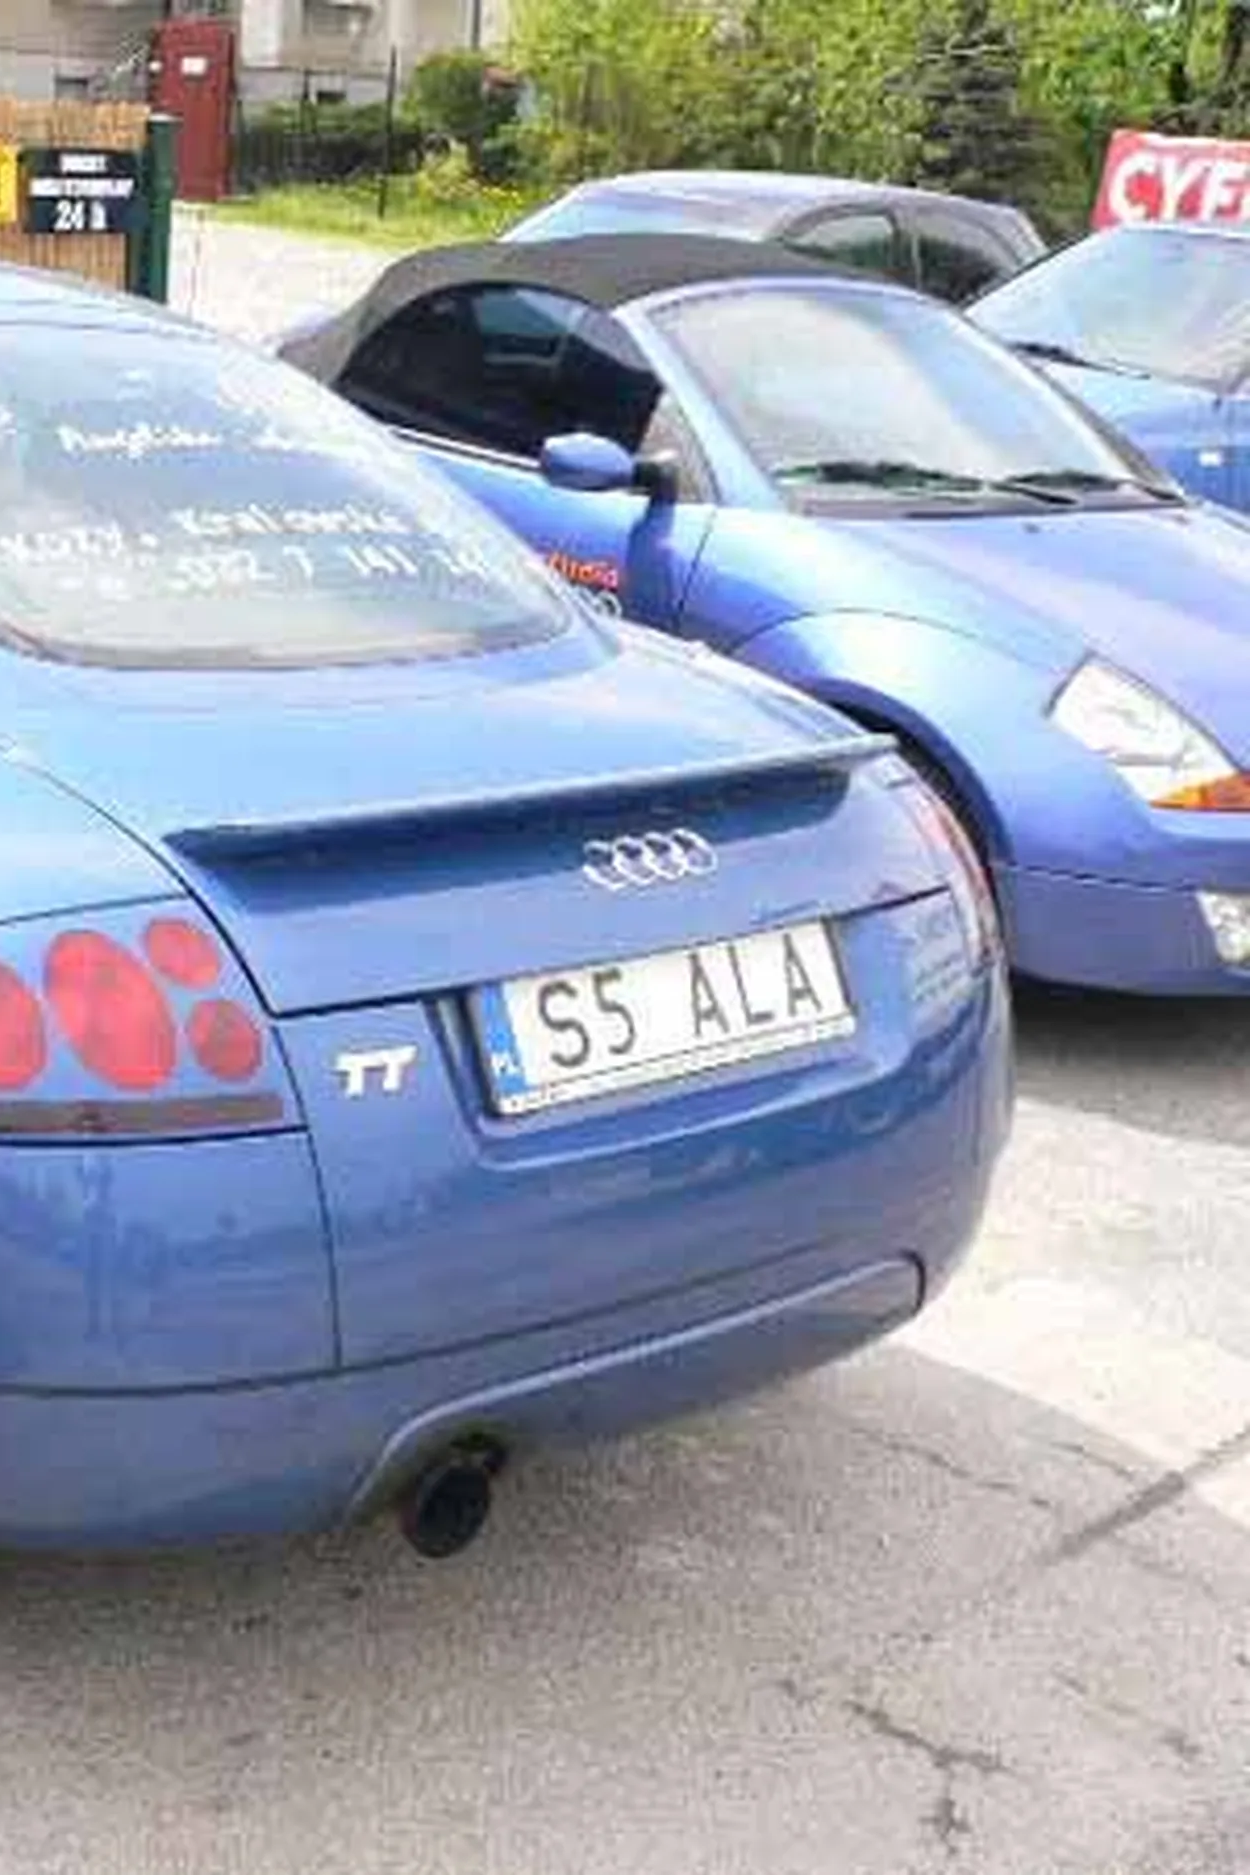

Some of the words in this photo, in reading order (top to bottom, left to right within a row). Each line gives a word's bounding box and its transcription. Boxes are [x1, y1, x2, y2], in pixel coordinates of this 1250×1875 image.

[1109, 152, 1250, 222] CYF
[537, 967, 636, 1069] S5
[687, 932, 824, 1056] ALA
[334, 1044, 418, 1097] TT
